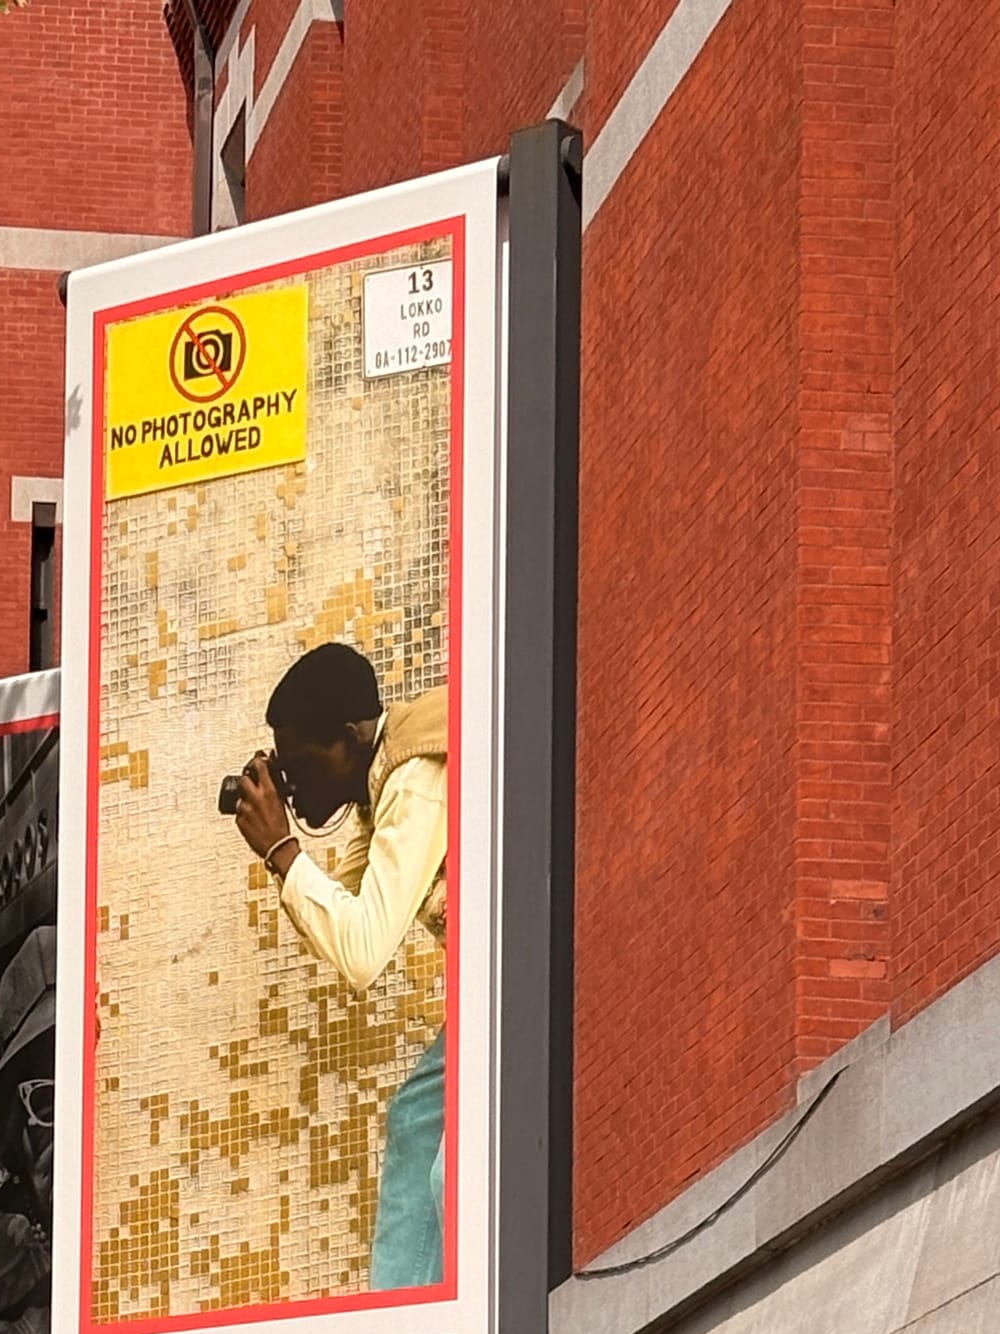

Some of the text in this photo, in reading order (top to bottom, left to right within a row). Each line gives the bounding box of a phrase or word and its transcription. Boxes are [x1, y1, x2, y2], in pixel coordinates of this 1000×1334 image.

[408, 269, 434, 294] 13
[400, 298, 443, 320] LOKKO
[413, 321, 430, 339] RD
[111, 388, 297, 450] NO PHOTOGRAPHY
[159, 426, 261, 469] ALLOWED
